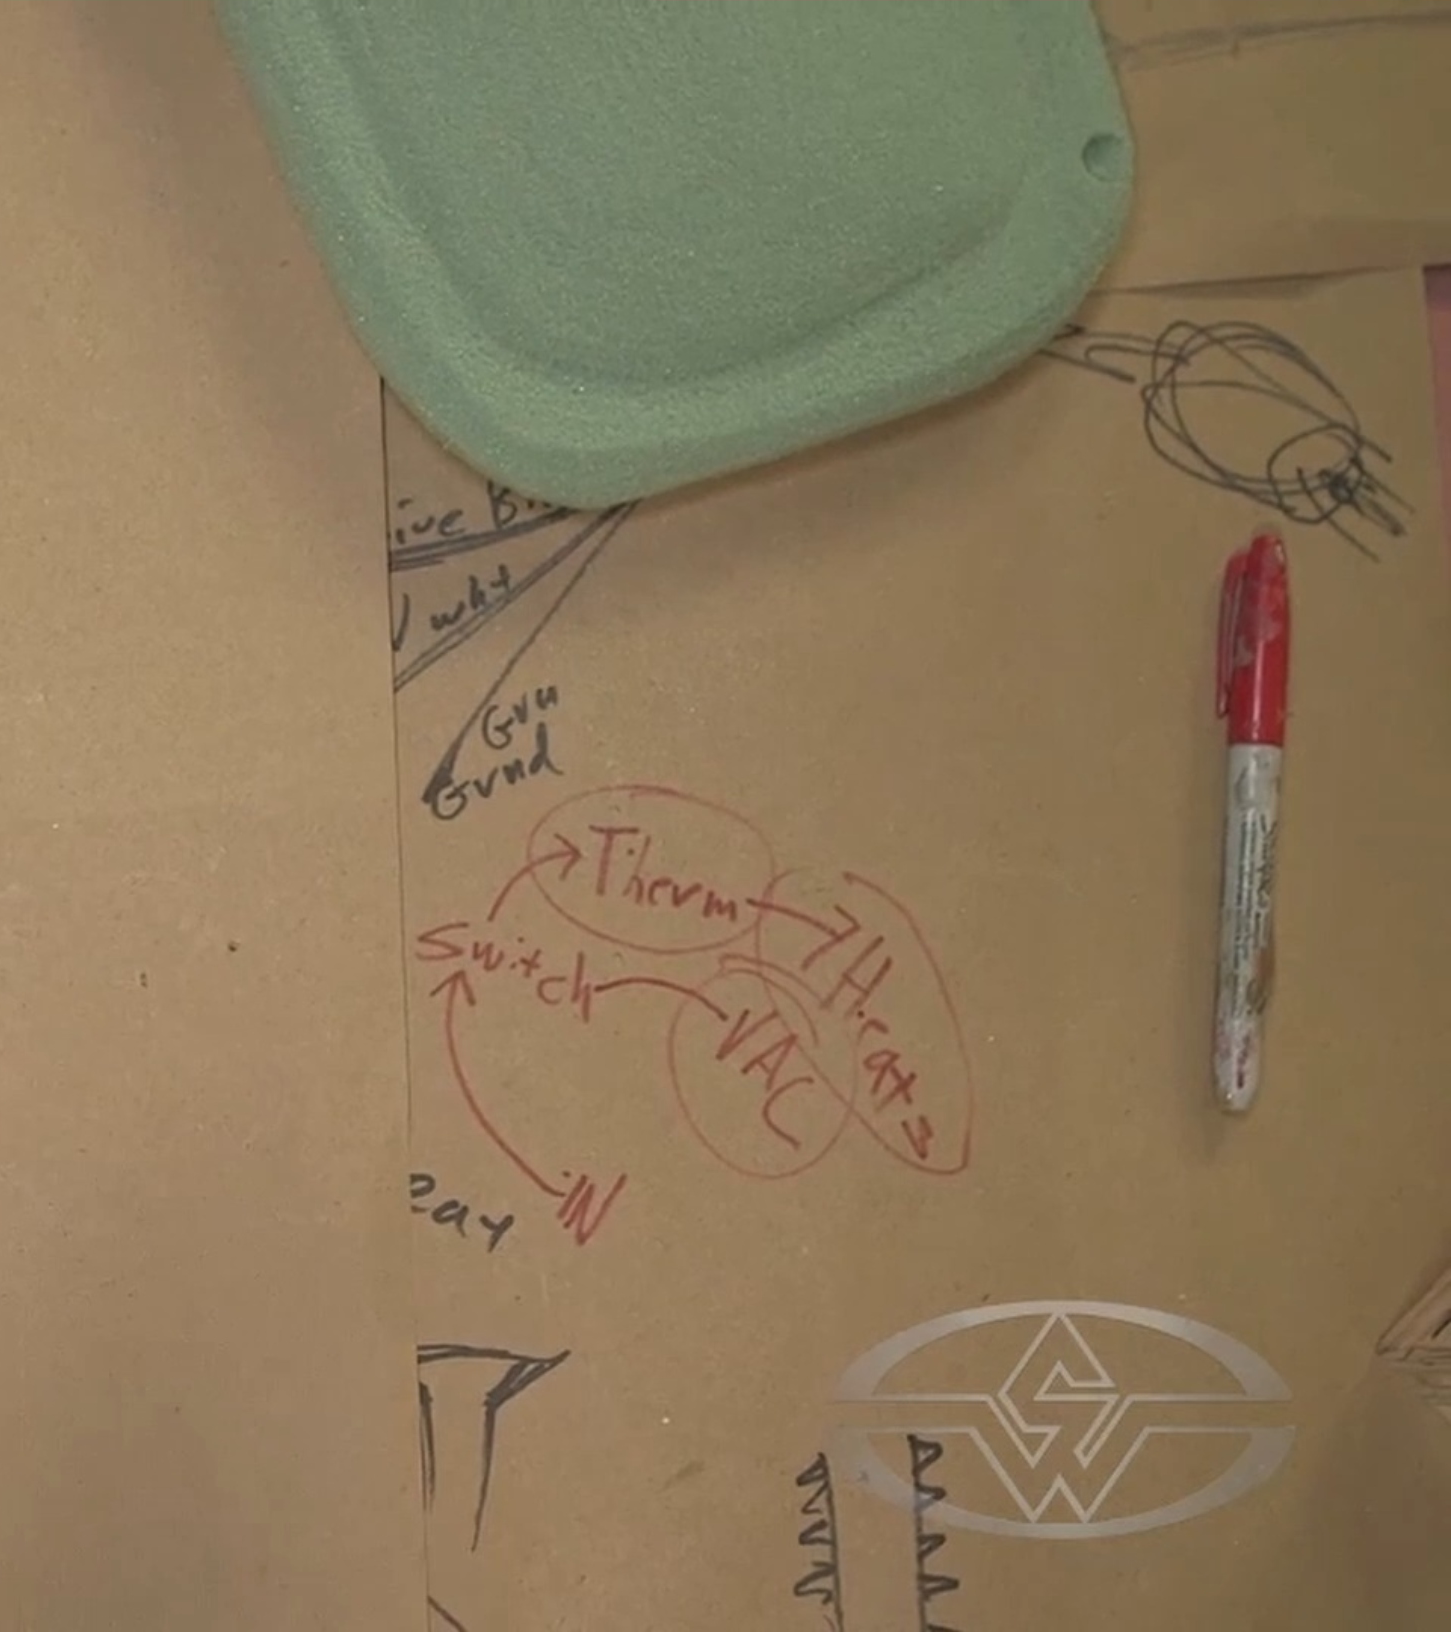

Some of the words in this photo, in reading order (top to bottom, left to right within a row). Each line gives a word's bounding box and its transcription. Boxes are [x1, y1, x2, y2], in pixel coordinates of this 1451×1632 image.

[588, 824, 738, 922] Therm
[415, 922, 590, 1023] Switch
[716, 1008, 815, 1150] VAC
